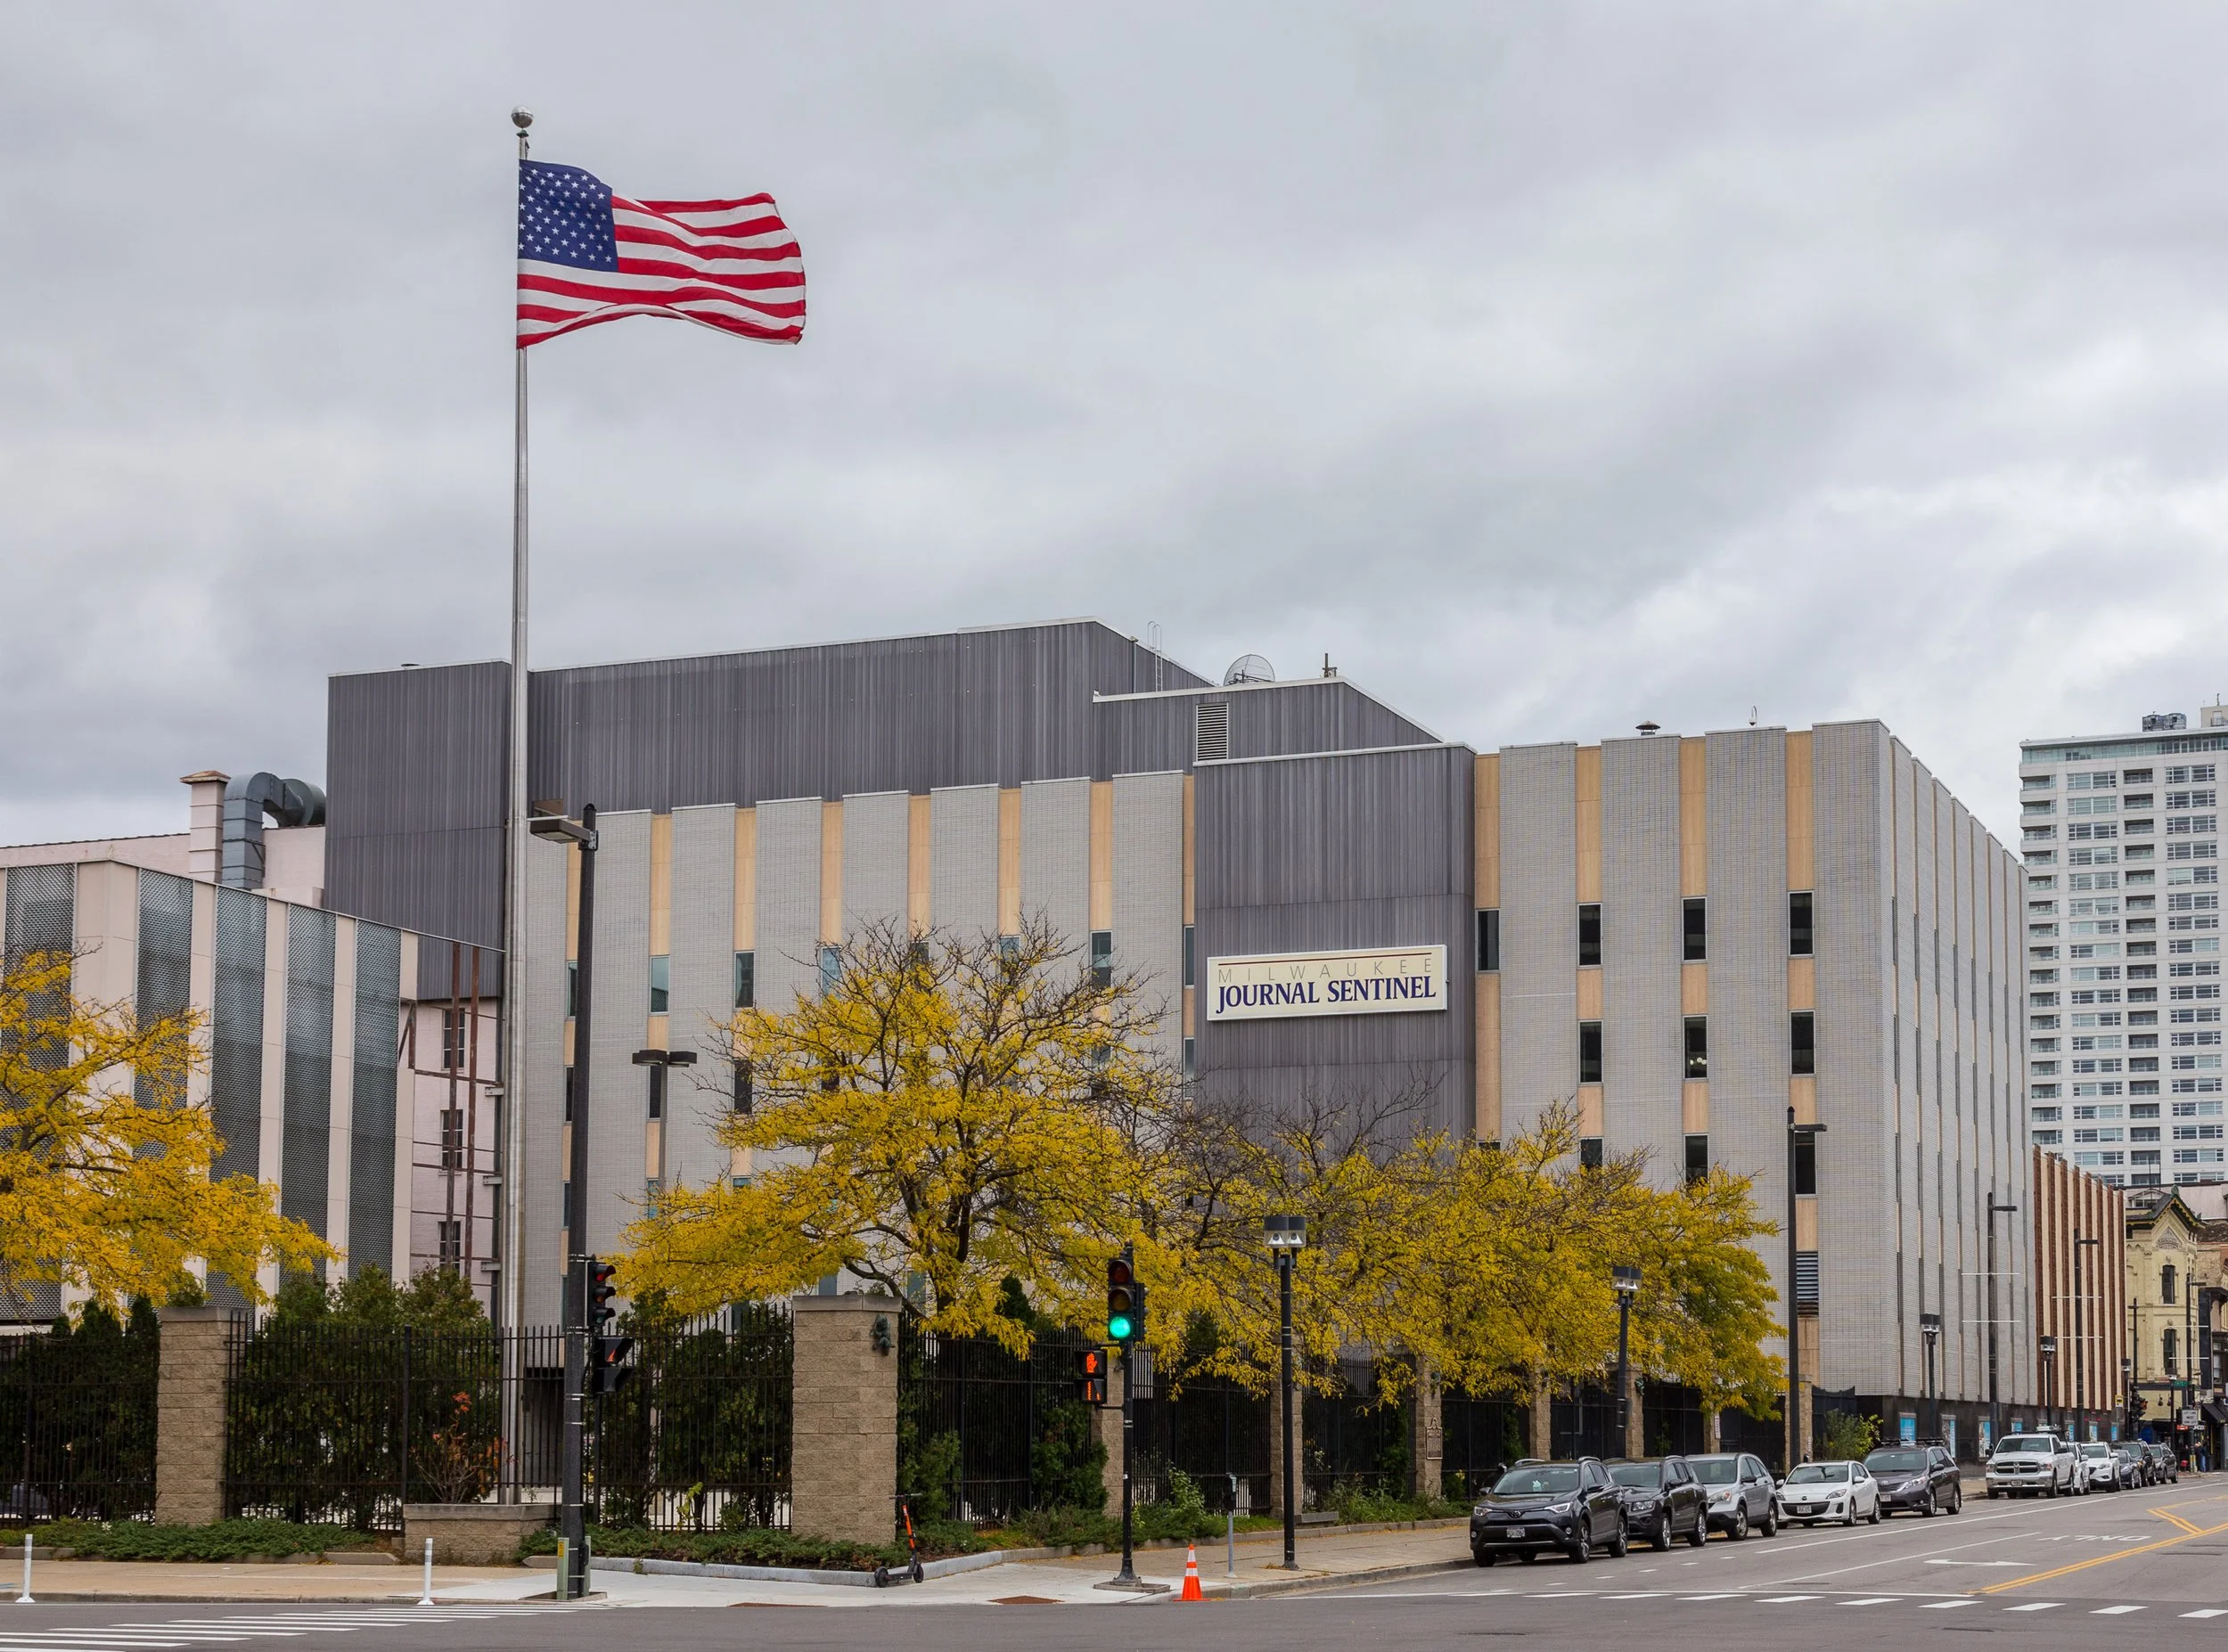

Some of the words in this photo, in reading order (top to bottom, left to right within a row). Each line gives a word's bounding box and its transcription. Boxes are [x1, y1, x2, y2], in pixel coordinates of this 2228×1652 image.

[1218, 958, 1432, 983] MILWAUKEE
[1216, 981, 1321, 1014] JOURNAL
[1327, 976, 1437, 1002] SENTINEL
